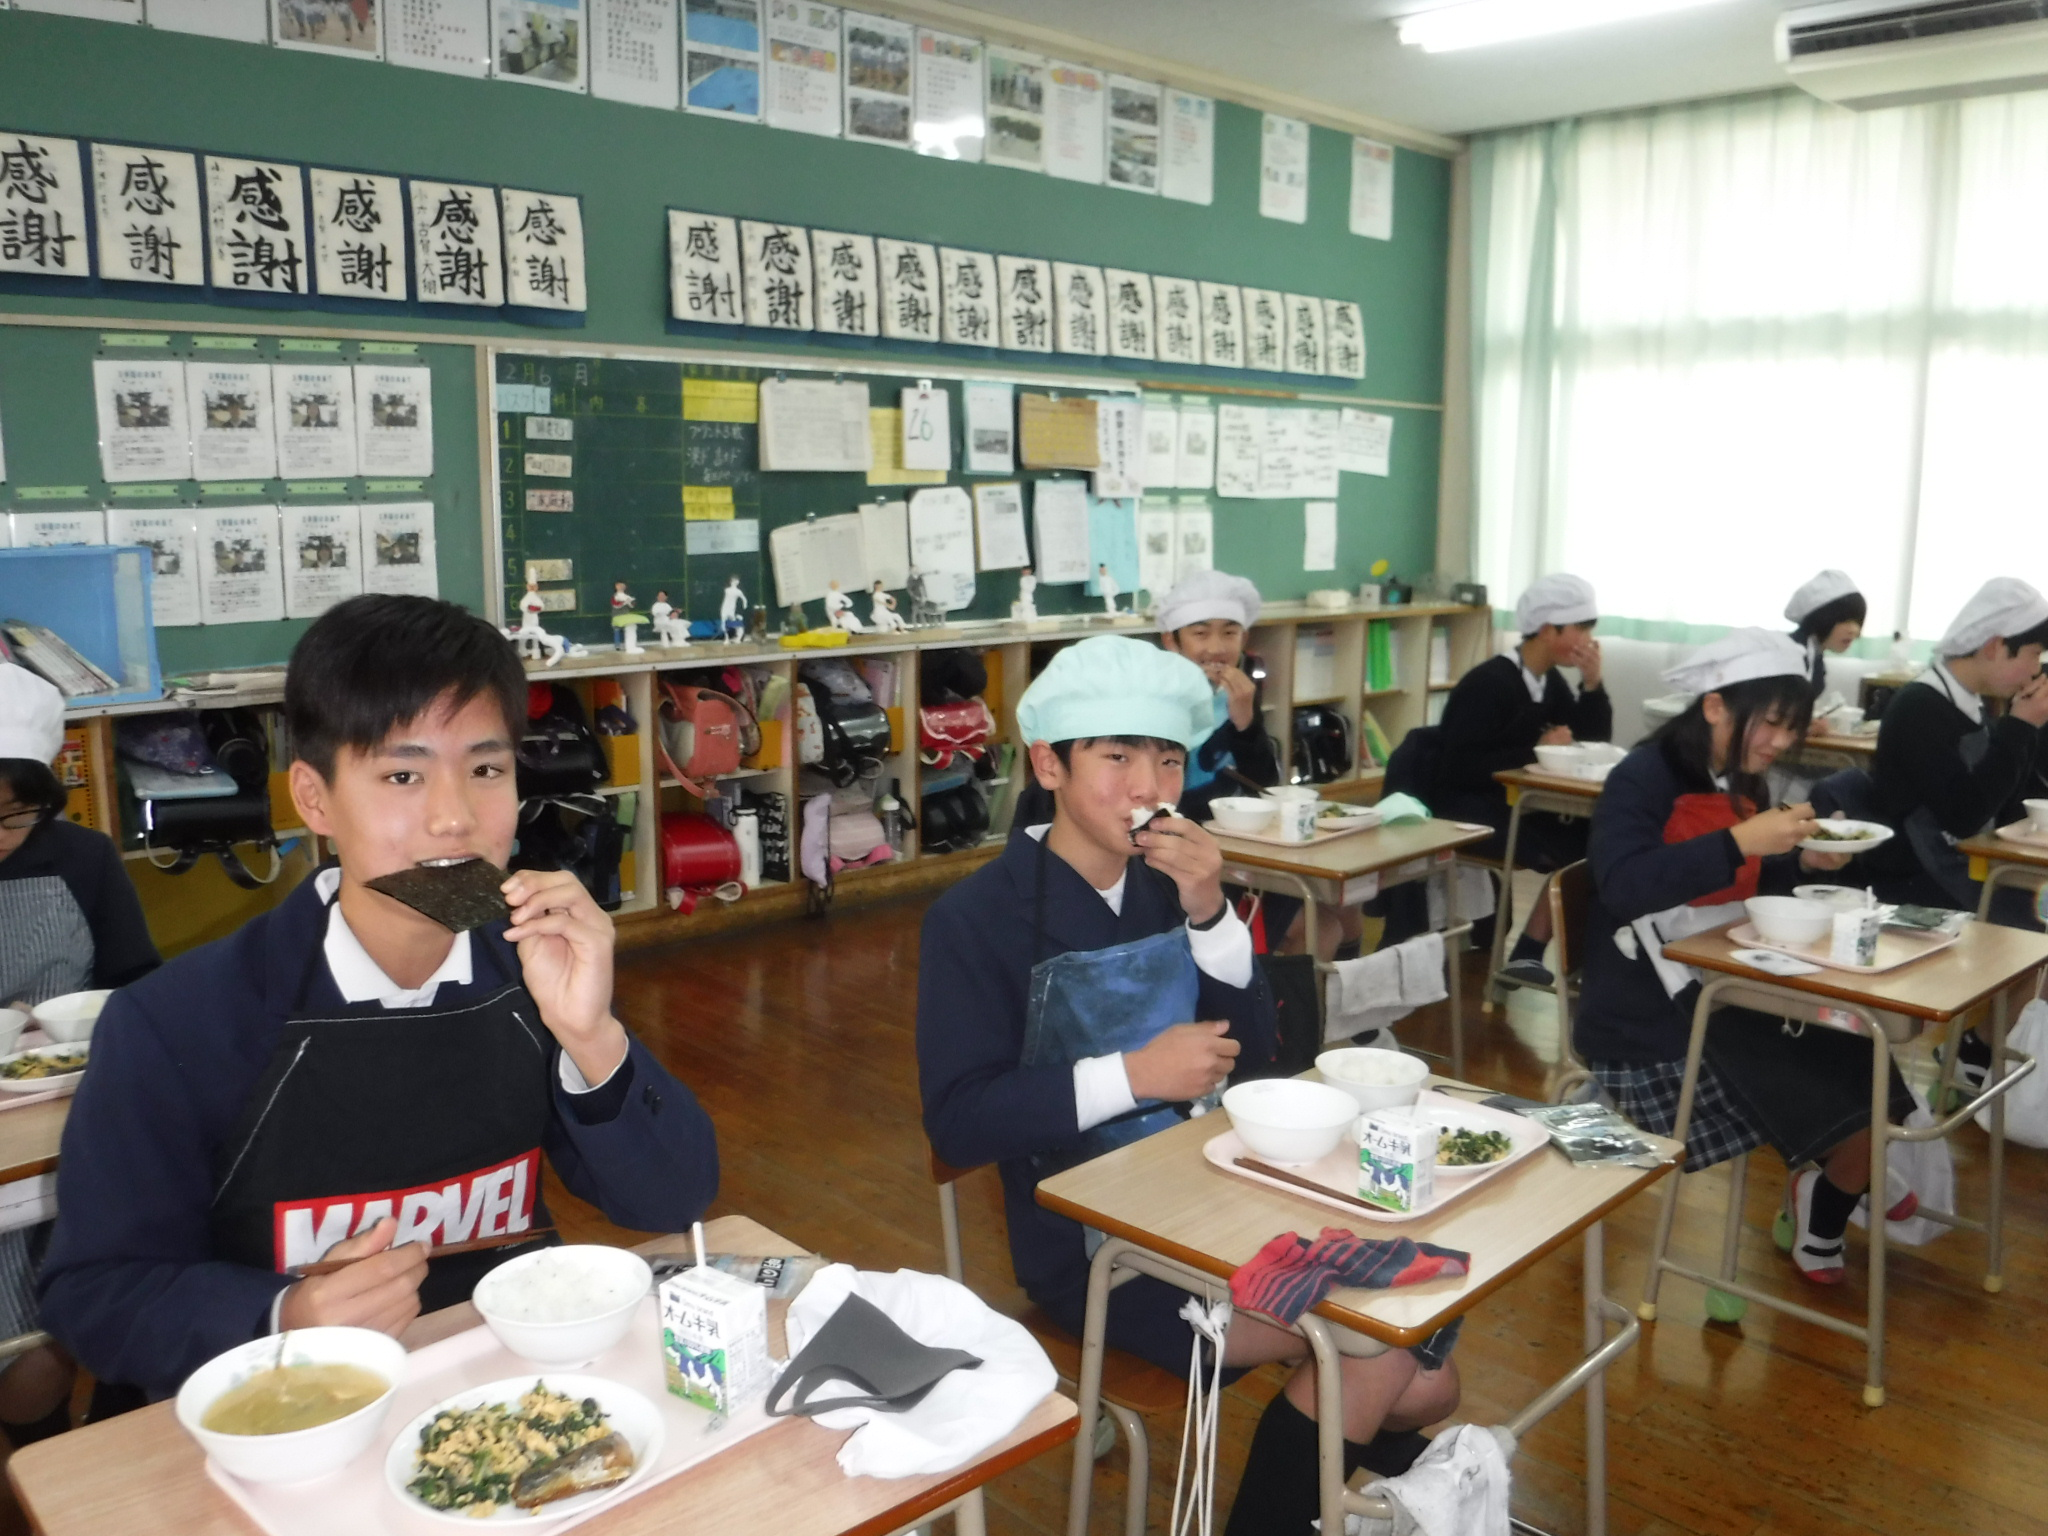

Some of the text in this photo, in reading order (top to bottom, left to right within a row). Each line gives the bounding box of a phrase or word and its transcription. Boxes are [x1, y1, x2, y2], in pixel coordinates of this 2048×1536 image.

[0, 139, 76, 268] 感謝
[121, 155, 181, 280] 感謝
[227, 167, 302, 292] 感謝
[331, 178, 393, 293] 感謝
[430, 188, 488, 299] 感謝
[518, 199, 569, 305] 感謝
[685, 221, 737, 319] 感謝
[760, 228, 804, 328] 感謝
[831, 241, 865, 333] 感謝
[896, 246, 931, 336] 感謝
[956, 258, 990, 341] 感謝
[1011, 264, 1047, 348] 感謝
[1068, 269, 1097, 351] 感謝
[1118, 280, 1146, 352] 感謝
[1166, 285, 1195, 360] 感謝
[1211, 289, 1237, 362] 感謝
[1255, 294, 1277, 365] 感謝
[504, 457, 514, 473] 2
[505, 490, 514, 508] 3
[507, 558, 517, 576] 5
[1363, 1131, 1412, 1157] オーム牛乳
[664, 1304, 722, 1339] オーム牛乳
